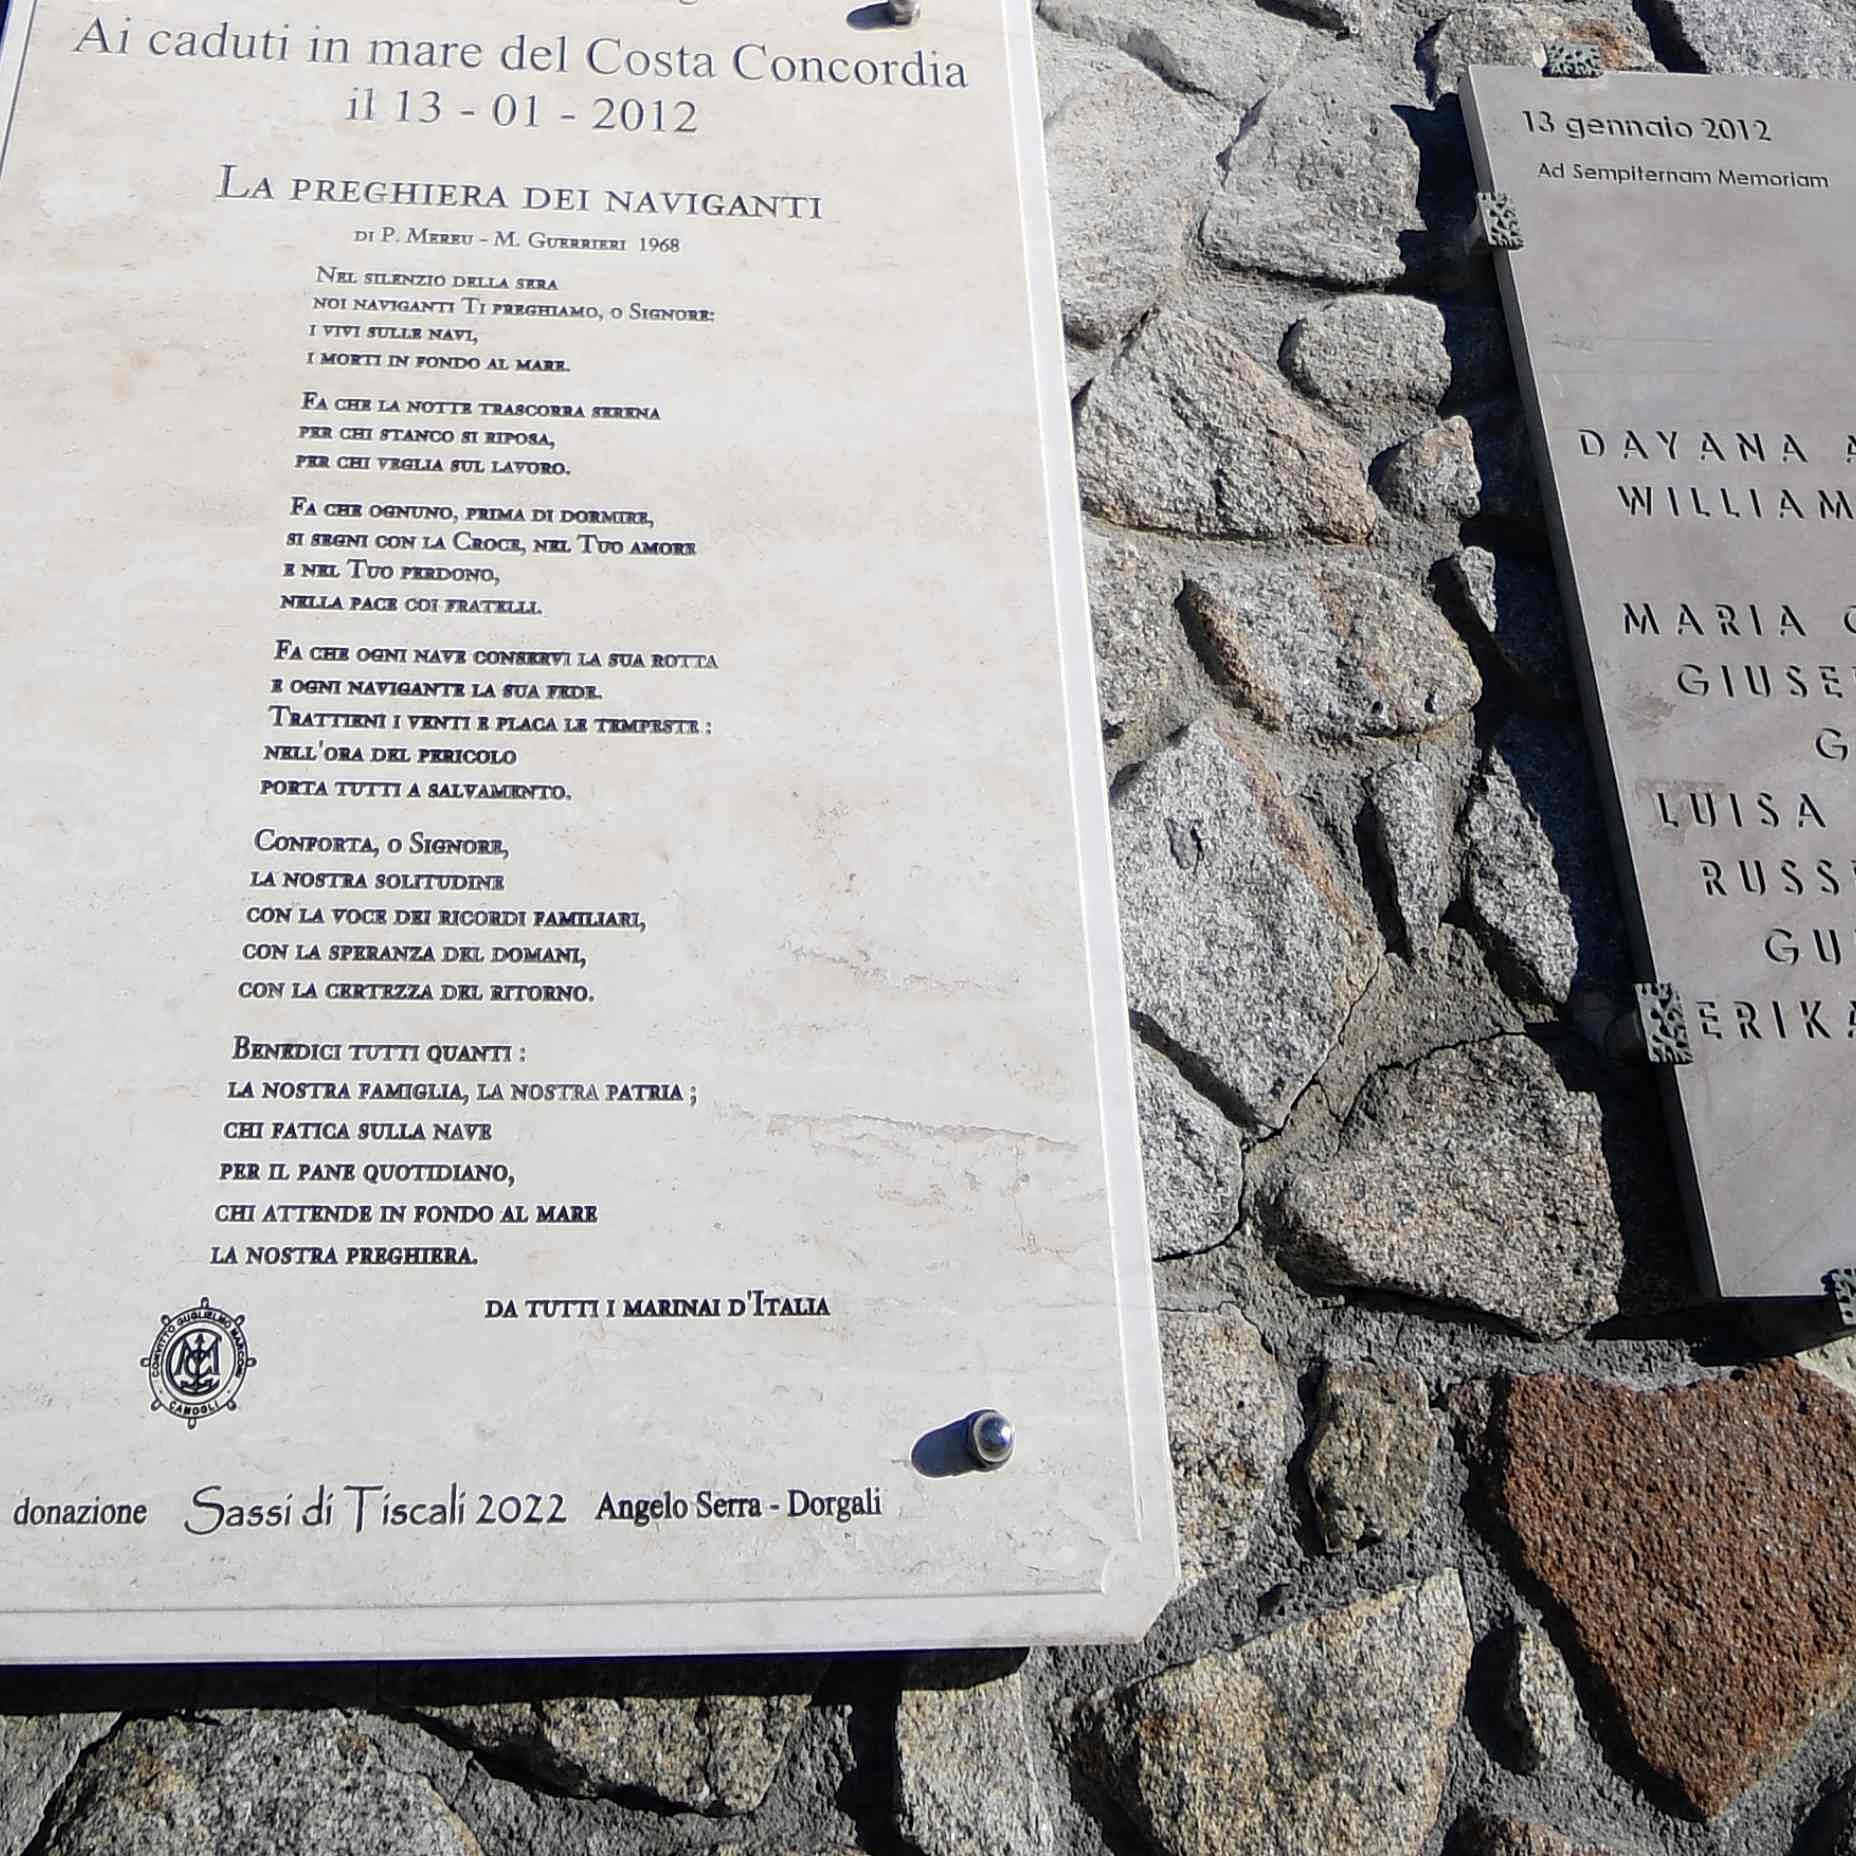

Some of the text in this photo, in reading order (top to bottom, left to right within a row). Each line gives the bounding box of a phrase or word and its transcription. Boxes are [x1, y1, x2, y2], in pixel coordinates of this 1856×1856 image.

[71, 16, 969, 89] Ai caduti in mare del Costa Concordia
[345, 87, 374, 121] il
[396, 89, 441, 124] 13
[492, 93, 539, 128] 01
[591, 97, 698, 133] 2012
[1521, 110, 1772, 142] 13 gennaio 2012
[1538, 162, 1829, 188] Ad Sempiternam Memoriam
[380, 226, 401, 243] P.
[493, 230, 521, 248] M.
[640, 236, 681, 253] 1968
[1578, 428, 1807, 465] DAYANA
[1622, 602, 1807, 637] MARIA
[1658, 792, 1826, 829] LUISA
[12, 1495, 148, 1527] donazione
[183, 1481, 568, 1536] Sassi di Tiscali 2022
[594, 1489, 689, 1530] Angelo
[696, 1489, 763, 1519] Serra
[786, 1486, 883, 1524] Dorgali
